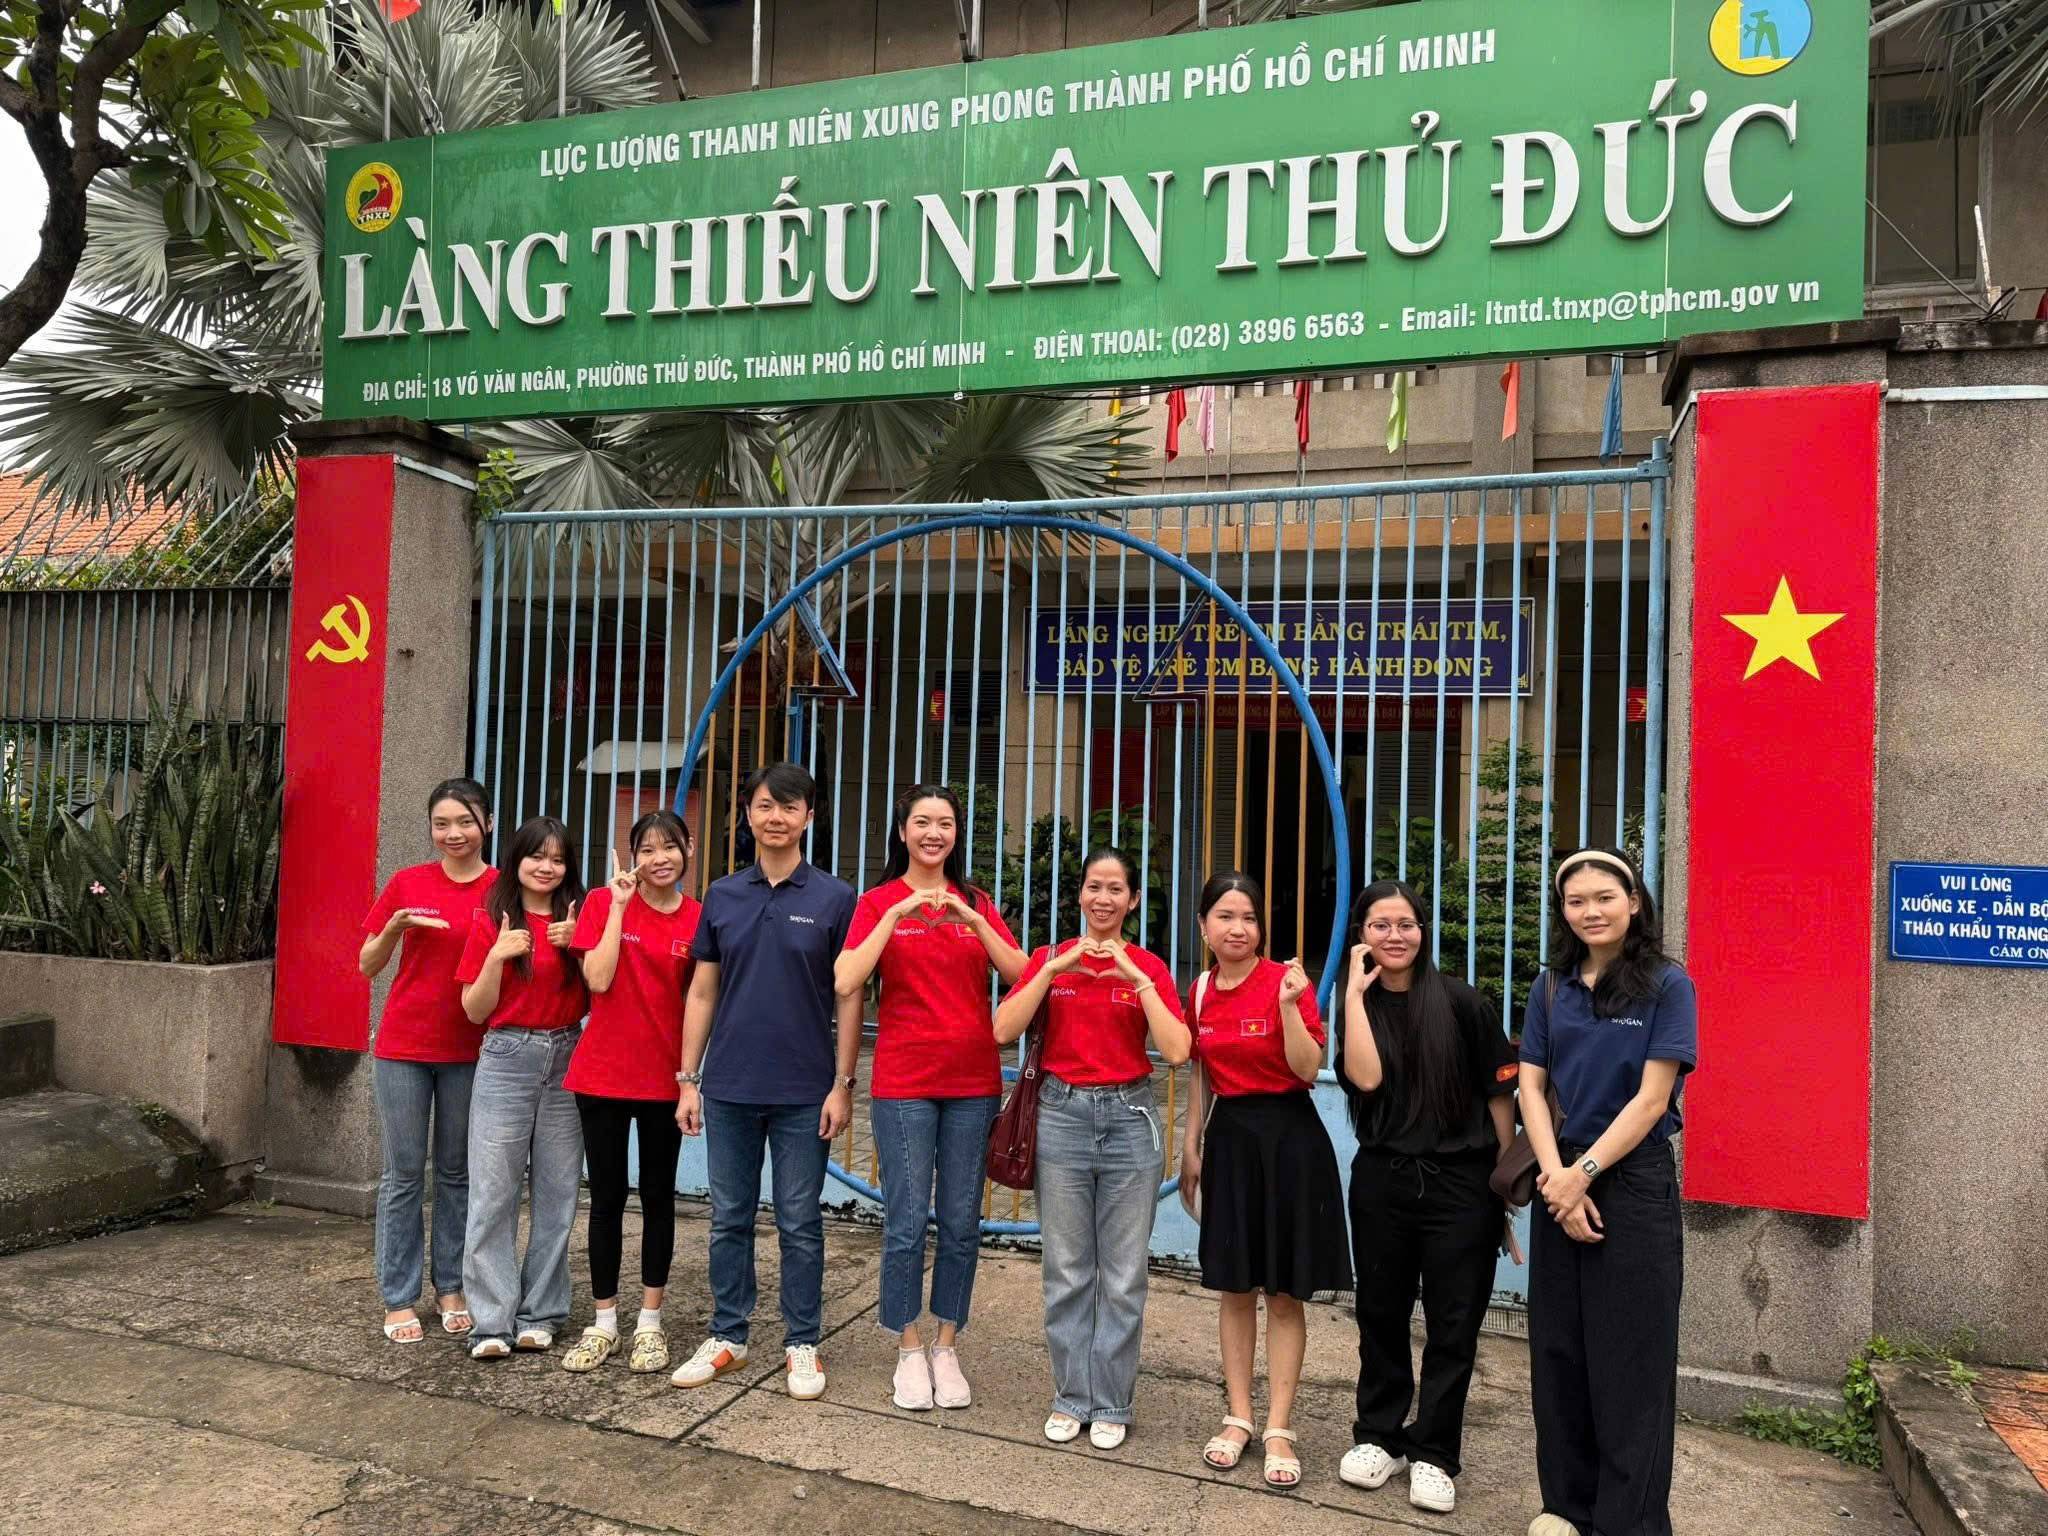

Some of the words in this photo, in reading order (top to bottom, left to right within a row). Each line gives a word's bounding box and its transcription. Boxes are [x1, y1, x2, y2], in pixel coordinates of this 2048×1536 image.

[541, 144, 587, 182] LỰC
[597, 133, 680, 173] LƯỢNG
[689, 120, 778, 159] THANH
[788, 107, 853, 148] NIÊN
[862, 100, 939, 139] XUNG
[951, 86, 1055, 128] PHONG
[1064, 70, 1172, 114] THÀNH
[1183, 47, 1256, 100] PHỐ
[1264, 41, 1311, 90] HỒ
[1323, 34, 1388, 83] CHÍ
[1398, 28, 1496, 74] MINH
[338, 216, 572, 340] LÀNG
[592, 176, 890, 318] THIẾU
[912, 146, 1174, 296] NIÊN
[1202, 110, 1461, 273] THỦ
[1489, 77, 1798, 249] ĐỨC
[356, 211, 391, 225] TNXP
[362, 382, 390, 406] ĐỊA
[394, 372, 427, 401] CHỈ:
[432, 377, 452, 398] 18
[456, 371, 479, 397] VÕ
[484, 369, 515, 394] VĂN
[521, 365, 571, 393] NGÂN,
[576, 362, 648, 389] PHƯỜNG
[653, 354, 689, 384] THỦ
[694, 354, 738, 383] ĐỨC,
[744, 350, 806, 379] THÀNH
[812, 341, 856, 375] PHỐ
[857, 339, 885, 373] HỒ
[891, 340, 927, 370] CHÍ
[932, 341, 986, 367] MINH
[1034, 330, 1084, 363] ĐIỆN
[1091, 328, 1163, 358] THOẠI:
[1171, 322, 1230, 354] (028)
[1238, 316, 1297, 345] 3896
[1304, 311, 1365, 339] 6563
[1401, 302, 1476, 332] Email:
[1788, 278, 1820, 302] vn
[1376, 616, 1439, 641] TRÁI
[1447, 621, 1507, 643] TIM,
[1940, 875, 1966, 890] VUI
[1971, 873, 2012, 892] LÒNG
[1900, 892, 1952, 914] XUỐNG
[1957, 899, 1977, 915] XE
[1903, 918, 1944, 936] THÁO
[1950, 917, 1991, 939] KHẨU
[1996, 925, 2048, 942] TRANG
